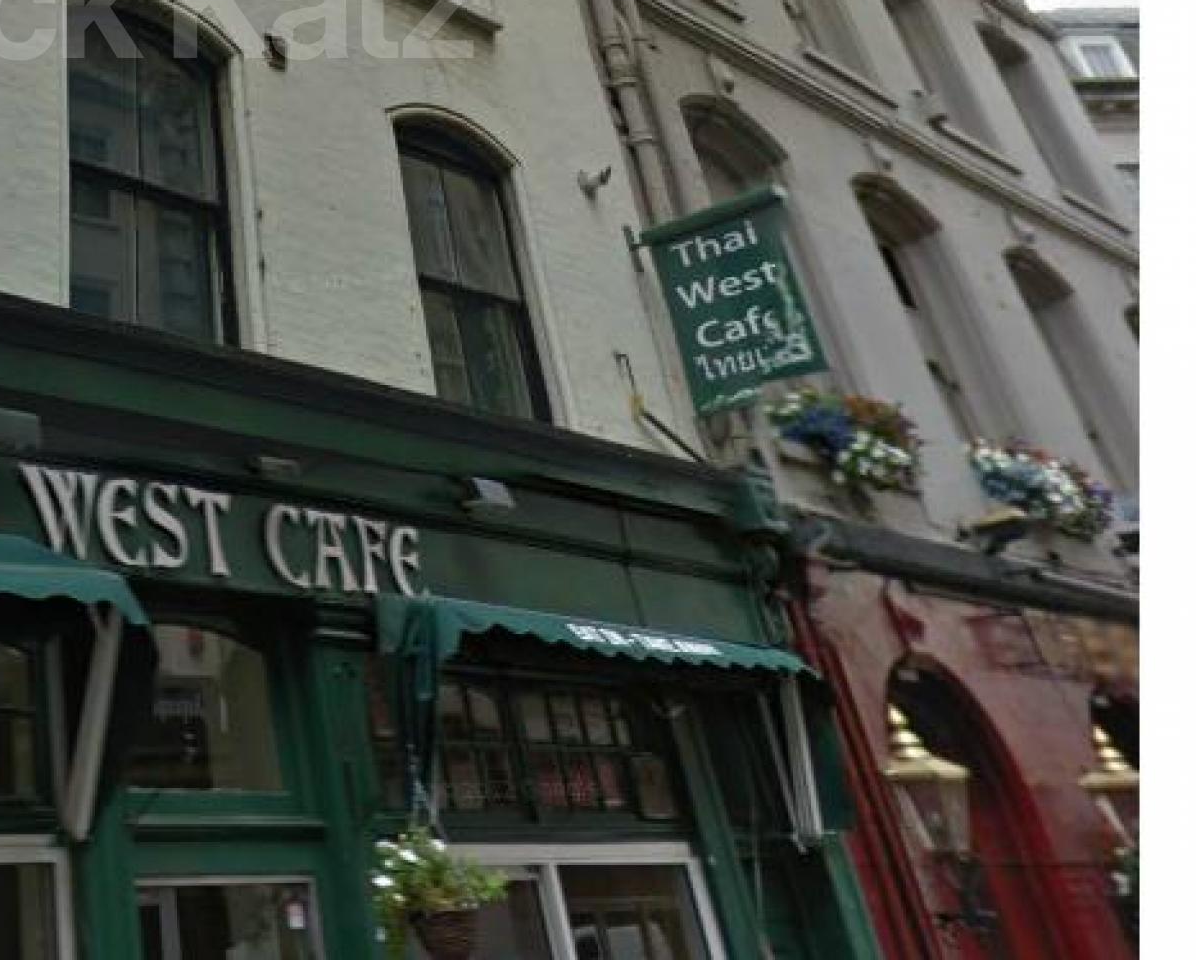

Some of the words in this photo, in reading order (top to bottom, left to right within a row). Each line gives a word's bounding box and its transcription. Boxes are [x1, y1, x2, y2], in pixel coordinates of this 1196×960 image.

[670, 220, 758, 267] Thai
[676, 261, 776, 309] West
[18, 464, 232, 577] WEST
[265, 503, 422, 598] CAFE
